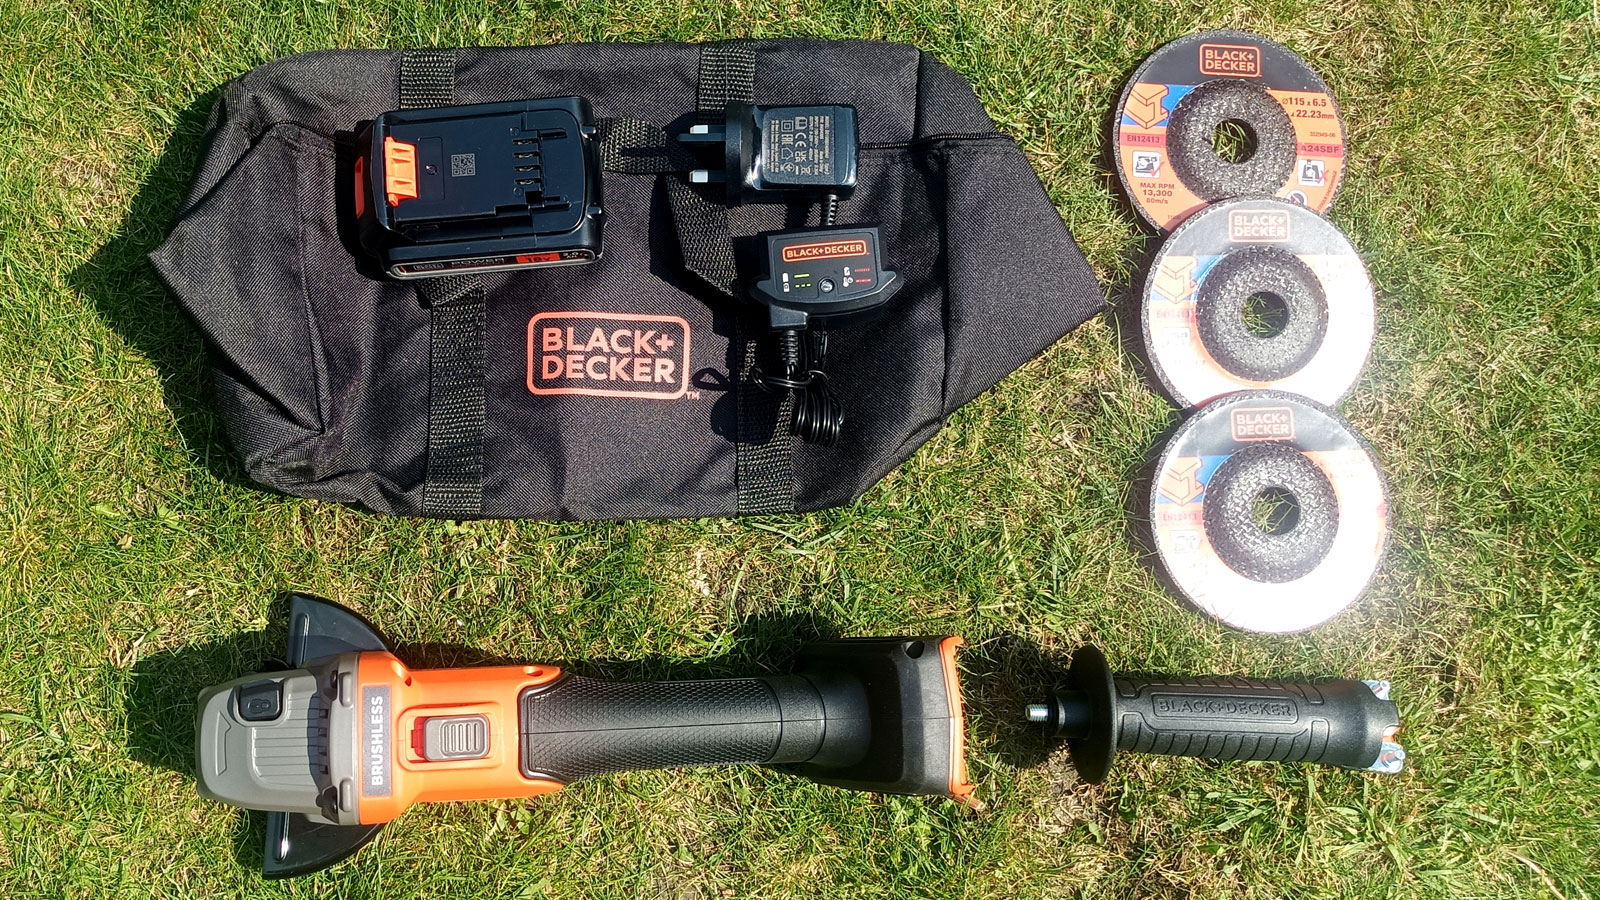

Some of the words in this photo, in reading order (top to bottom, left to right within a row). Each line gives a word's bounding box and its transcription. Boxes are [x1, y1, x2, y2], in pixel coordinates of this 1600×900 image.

[1205, 49, 1255, 61] BLACK+
[1205, 60, 1256, 72] DECKER
[1312, 99, 1327, 107] 6.5
[1296, 109, 1335, 119] 22.23mm
[1127, 135, 1160, 143] EN12413
[1301, 144, 1340, 153] A24SBF
[1143, 189, 1173, 197] 13,300
[1234, 215, 1285, 226] BLACK+
[1234, 226, 1286, 237] DECKER
[786, 244, 863, 258] BLACK+DECKER
[542, 327, 675, 354] BLACK+
[542, 354, 676, 384] DECKER
[1236, 413, 1288, 424] BLACK+
[1237, 424, 1289, 435] DECKER
[1158, 700, 1293, 716] BLACK+DECKER
[371, 696, 384, 786] BRUSHLESS
